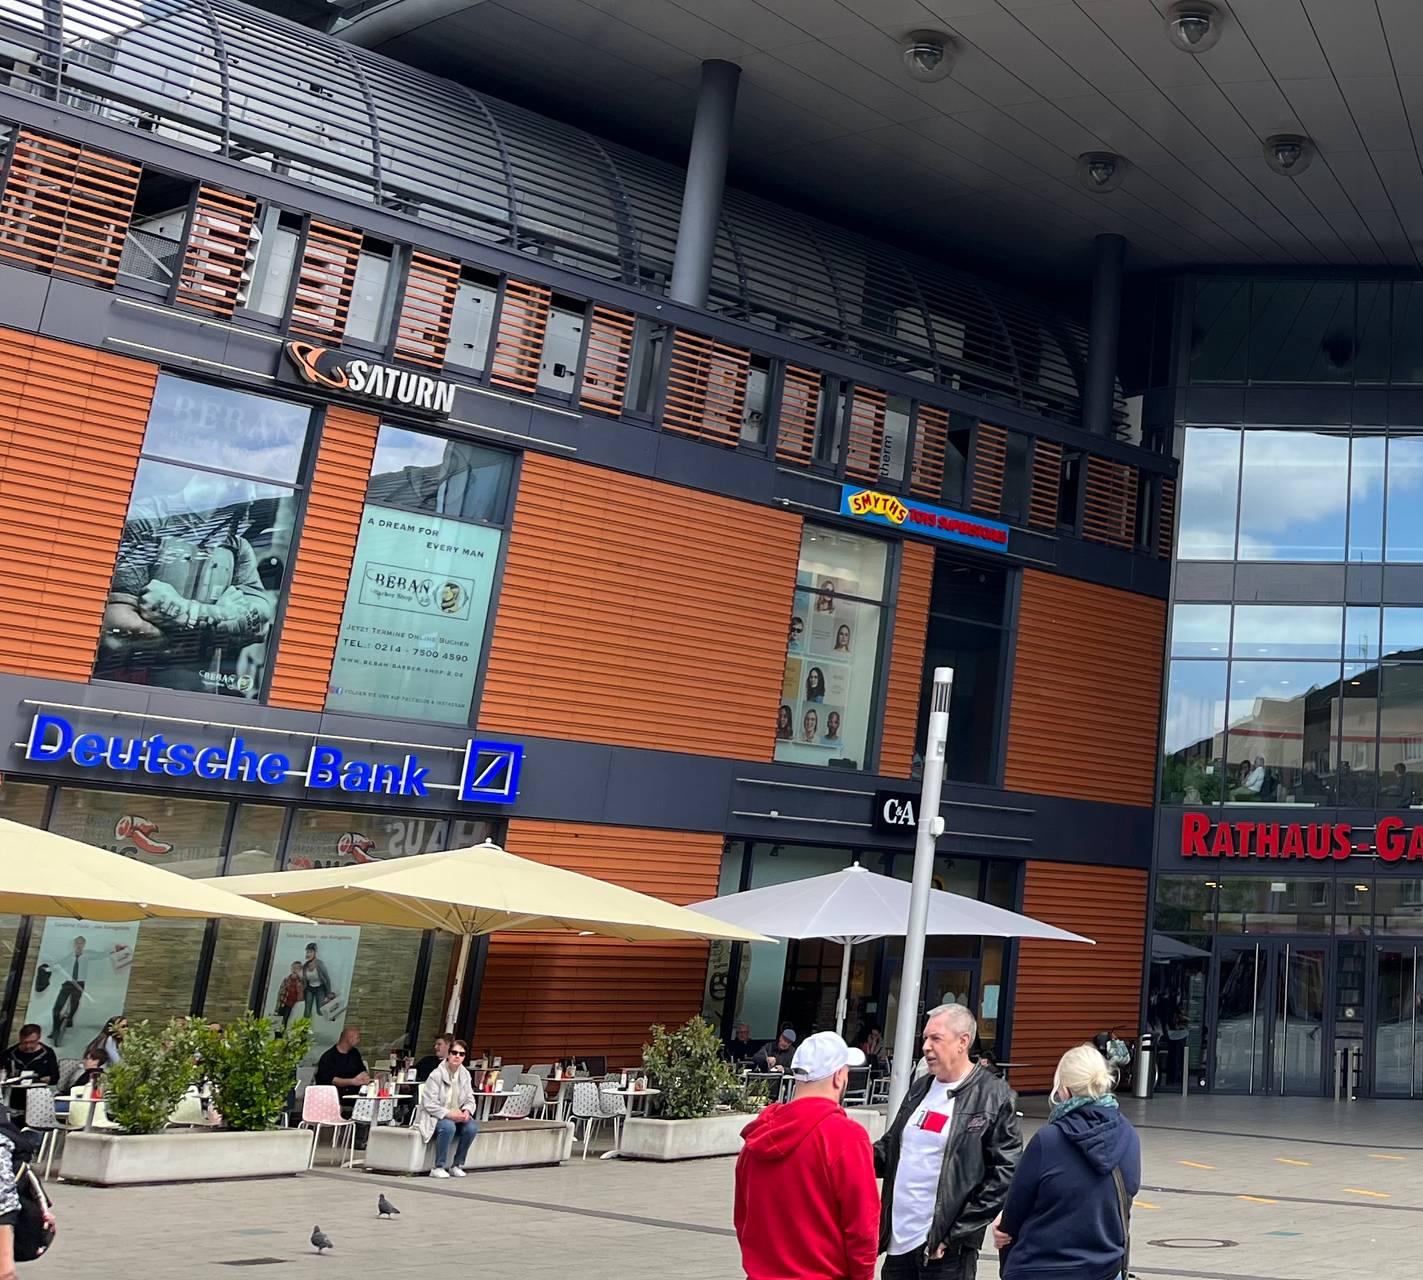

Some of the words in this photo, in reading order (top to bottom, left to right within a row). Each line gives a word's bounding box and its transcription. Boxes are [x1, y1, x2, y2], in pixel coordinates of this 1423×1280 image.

[347, 359, 456, 413] SATURN
[853, 493, 907, 522] SMYTHS
[367, 517, 375, 526] A
[378, 519, 415, 533] DREAM
[418, 527, 440, 537] FOR
[426, 541, 460, 555] EVERY
[462, 549, 485, 559] MAN
[374, 643, 401, 653] 0214
[412, 648, 439, 659] 7500
[441, 653, 469, 663] 4590
[26, 712, 291, 785] Deutsche
[305, 744, 431, 798] Bank
[883, 798, 916, 826] C&A
